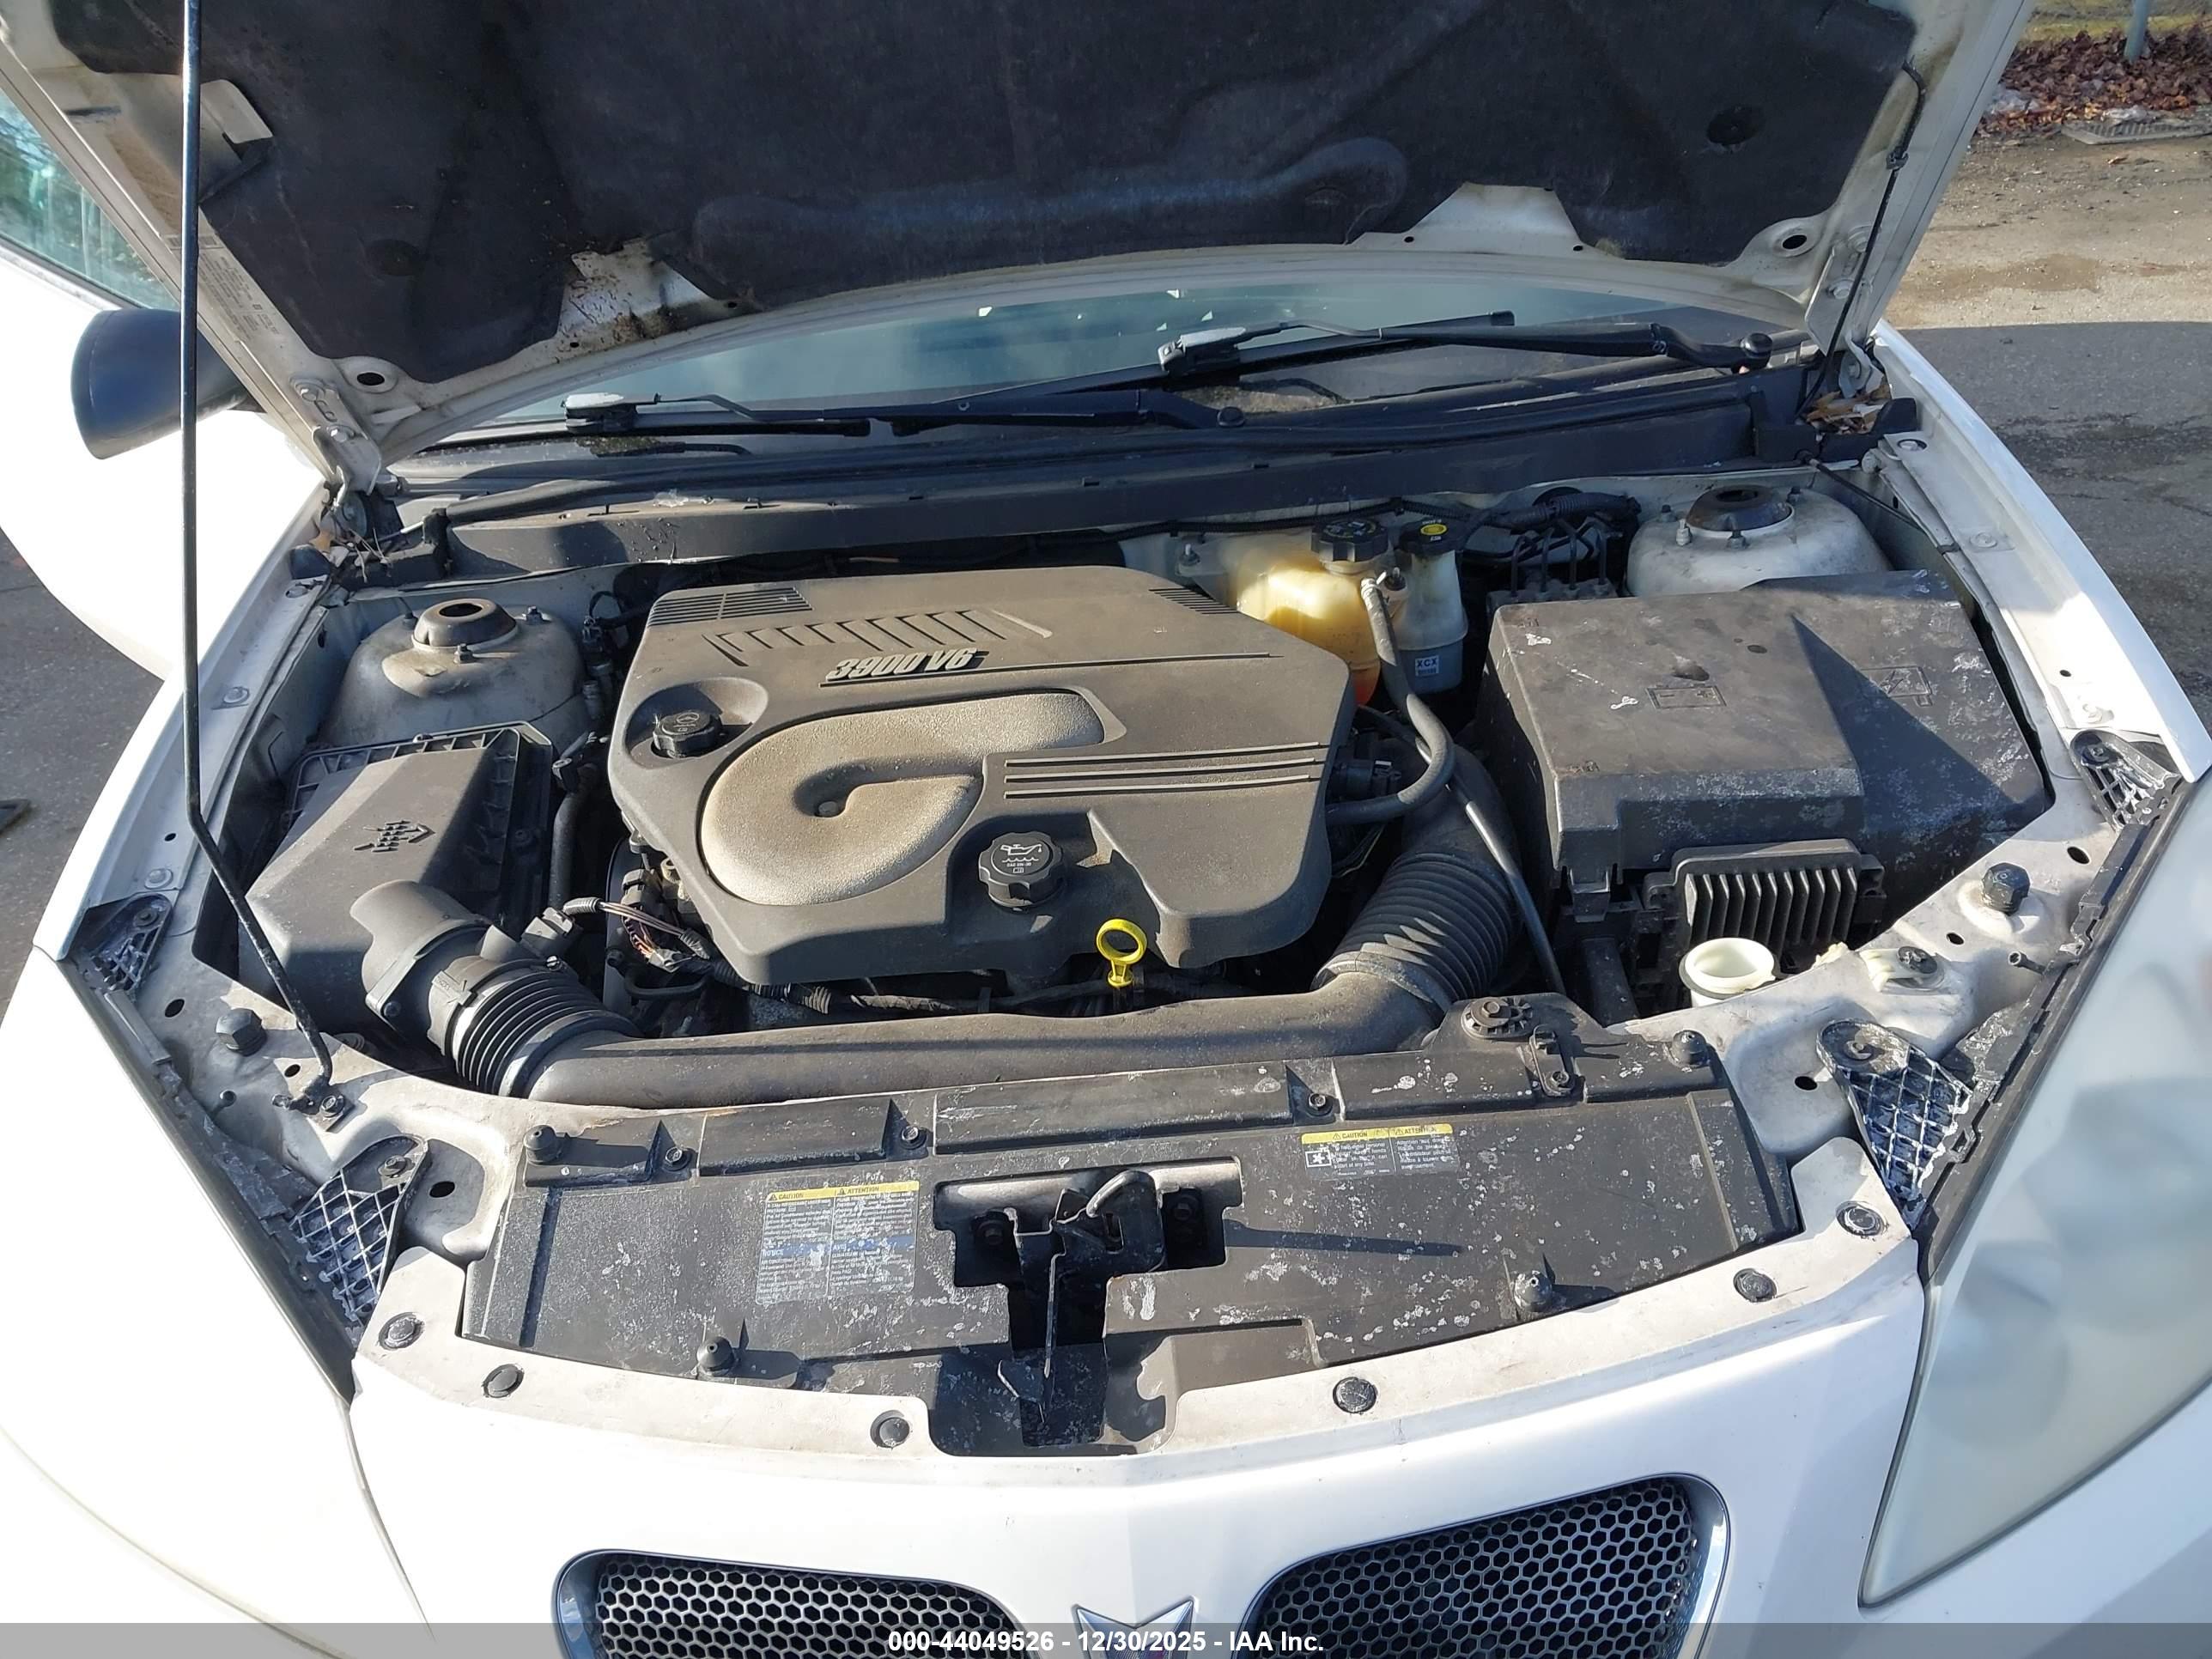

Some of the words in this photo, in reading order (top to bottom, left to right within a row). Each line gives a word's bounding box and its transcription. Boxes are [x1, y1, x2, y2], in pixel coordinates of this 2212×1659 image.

[825, 652, 926, 682] 3900
[924, 647, 977, 672] V6
[1341, 1131, 1368, 1139] CAUTION
[848, 1186, 880, 1194] ATTENTION
[778, 1192, 805, 1200] CAUTION
